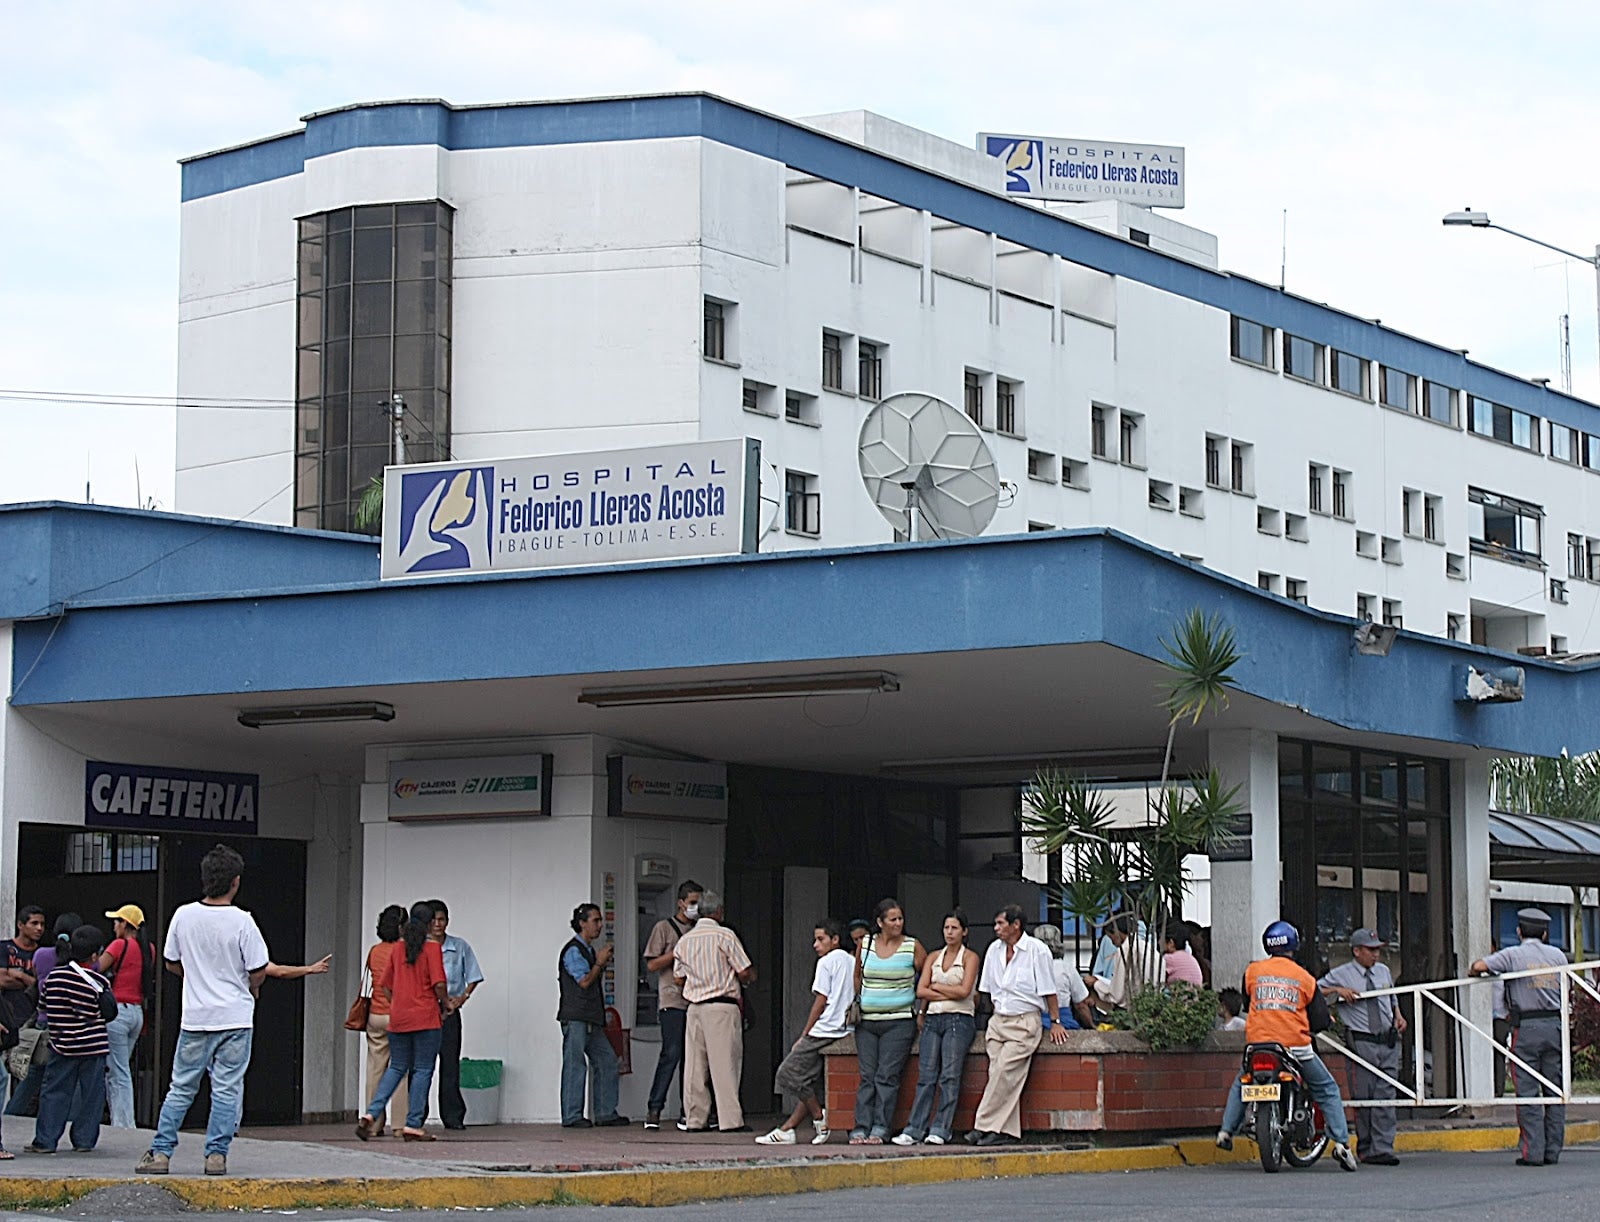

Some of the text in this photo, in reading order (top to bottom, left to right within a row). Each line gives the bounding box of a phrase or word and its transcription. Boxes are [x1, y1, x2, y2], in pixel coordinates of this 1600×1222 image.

[1049, 146, 1178, 164] HOSPITAL
[1049, 159, 1178, 186] Federico Lleras Acosta
[501, 459, 726, 493] HOSPITAL
[499, 482, 725, 534] Federico Lleras Acosta
[498, 535, 564, 554] IBAGUE
[583, 528, 649, 547] TOLIMA
[669, 522, 725, 540] E.S.E.
[91, 773, 255, 822] CAFETERIA
[420, 780, 456, 789] CAJEROS
